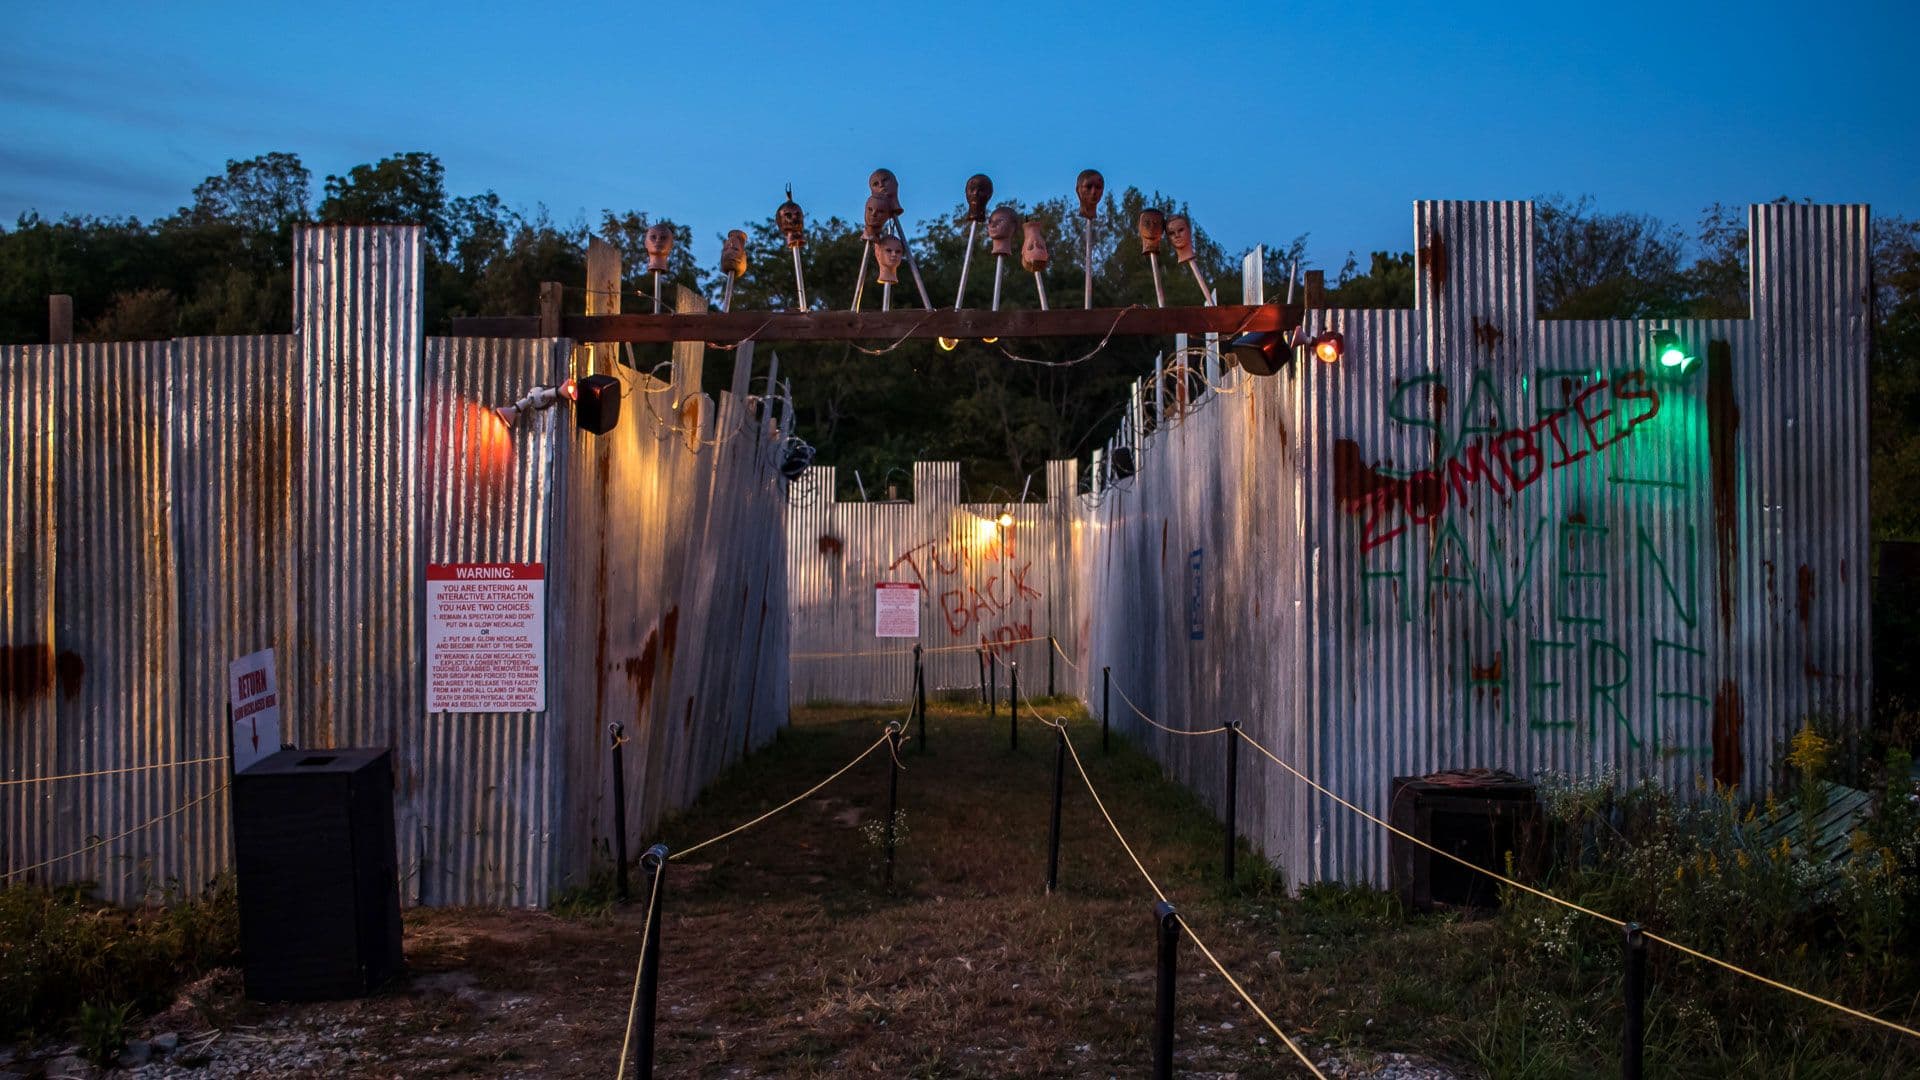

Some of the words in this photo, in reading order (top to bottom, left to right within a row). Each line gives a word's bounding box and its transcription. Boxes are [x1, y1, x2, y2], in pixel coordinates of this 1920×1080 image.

[1350, 369, 1660, 554] ZOMBIES
[1375, 366, 1696, 488] SAFE
[457, 567, 514, 578] WARNING:
[940, 561, 1042, 636] BACK
[1360, 516, 1697, 629] HAVEN
[238, 667, 267, 700] RETURN
[980, 609, 1034, 666] NOW
[1464, 637, 1713, 757] HERE
